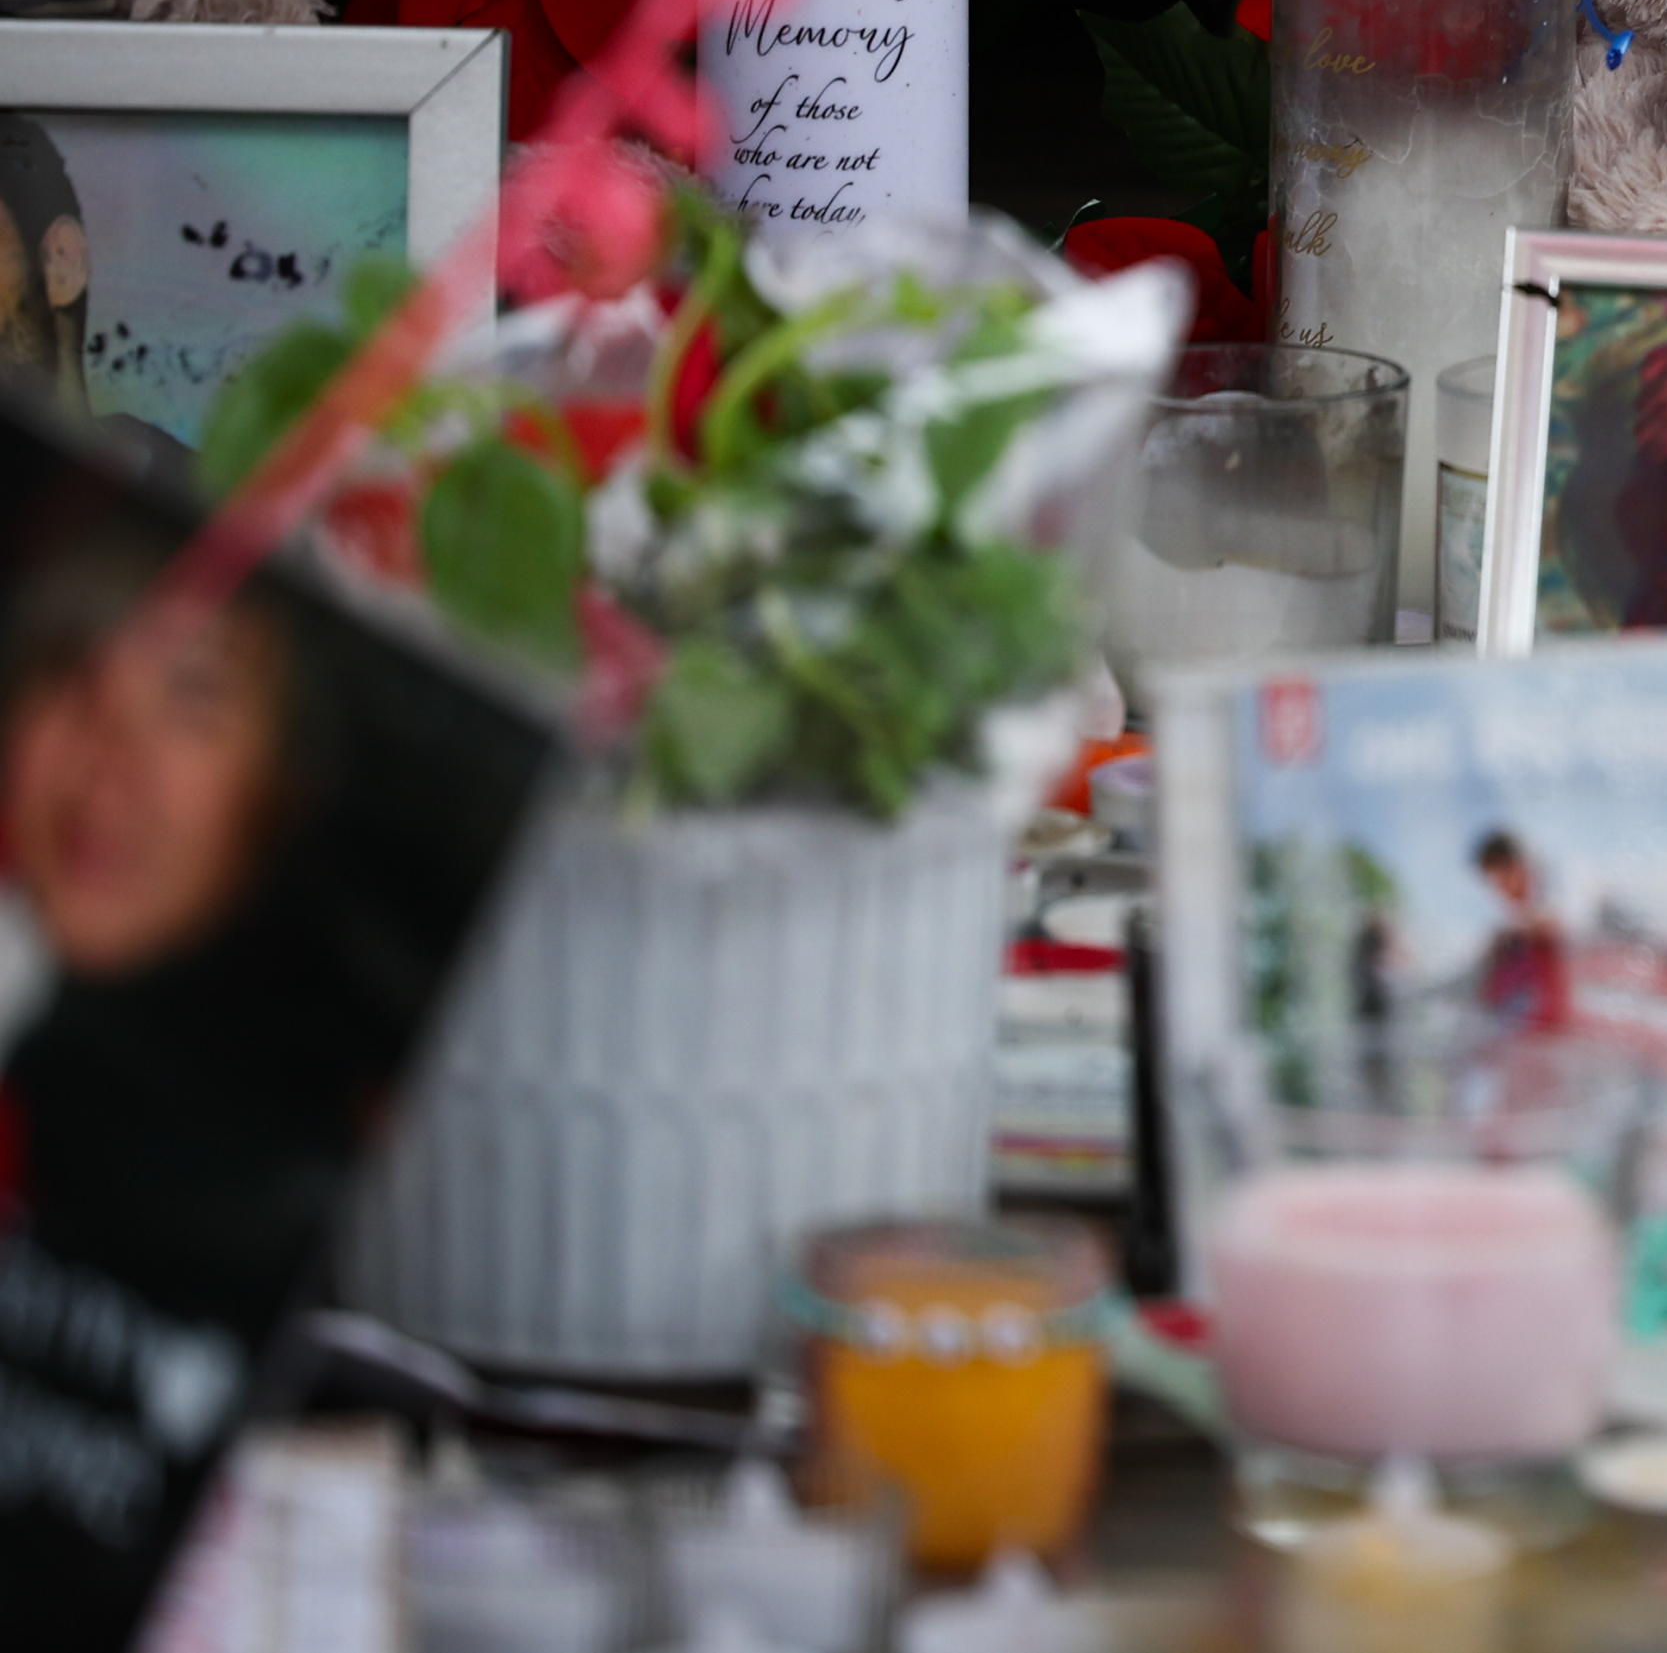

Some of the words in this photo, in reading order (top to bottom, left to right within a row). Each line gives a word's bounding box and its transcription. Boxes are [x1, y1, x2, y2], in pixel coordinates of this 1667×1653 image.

[1304, 26, 1377, 75] love
[730, 75, 799, 144] of
[795, 78, 863, 122] those
[733, 125, 784, 168] who
[785, 153, 830, 171] are
[836, 147, 880, 171] not
[1300, 322, 1334, 348] us
